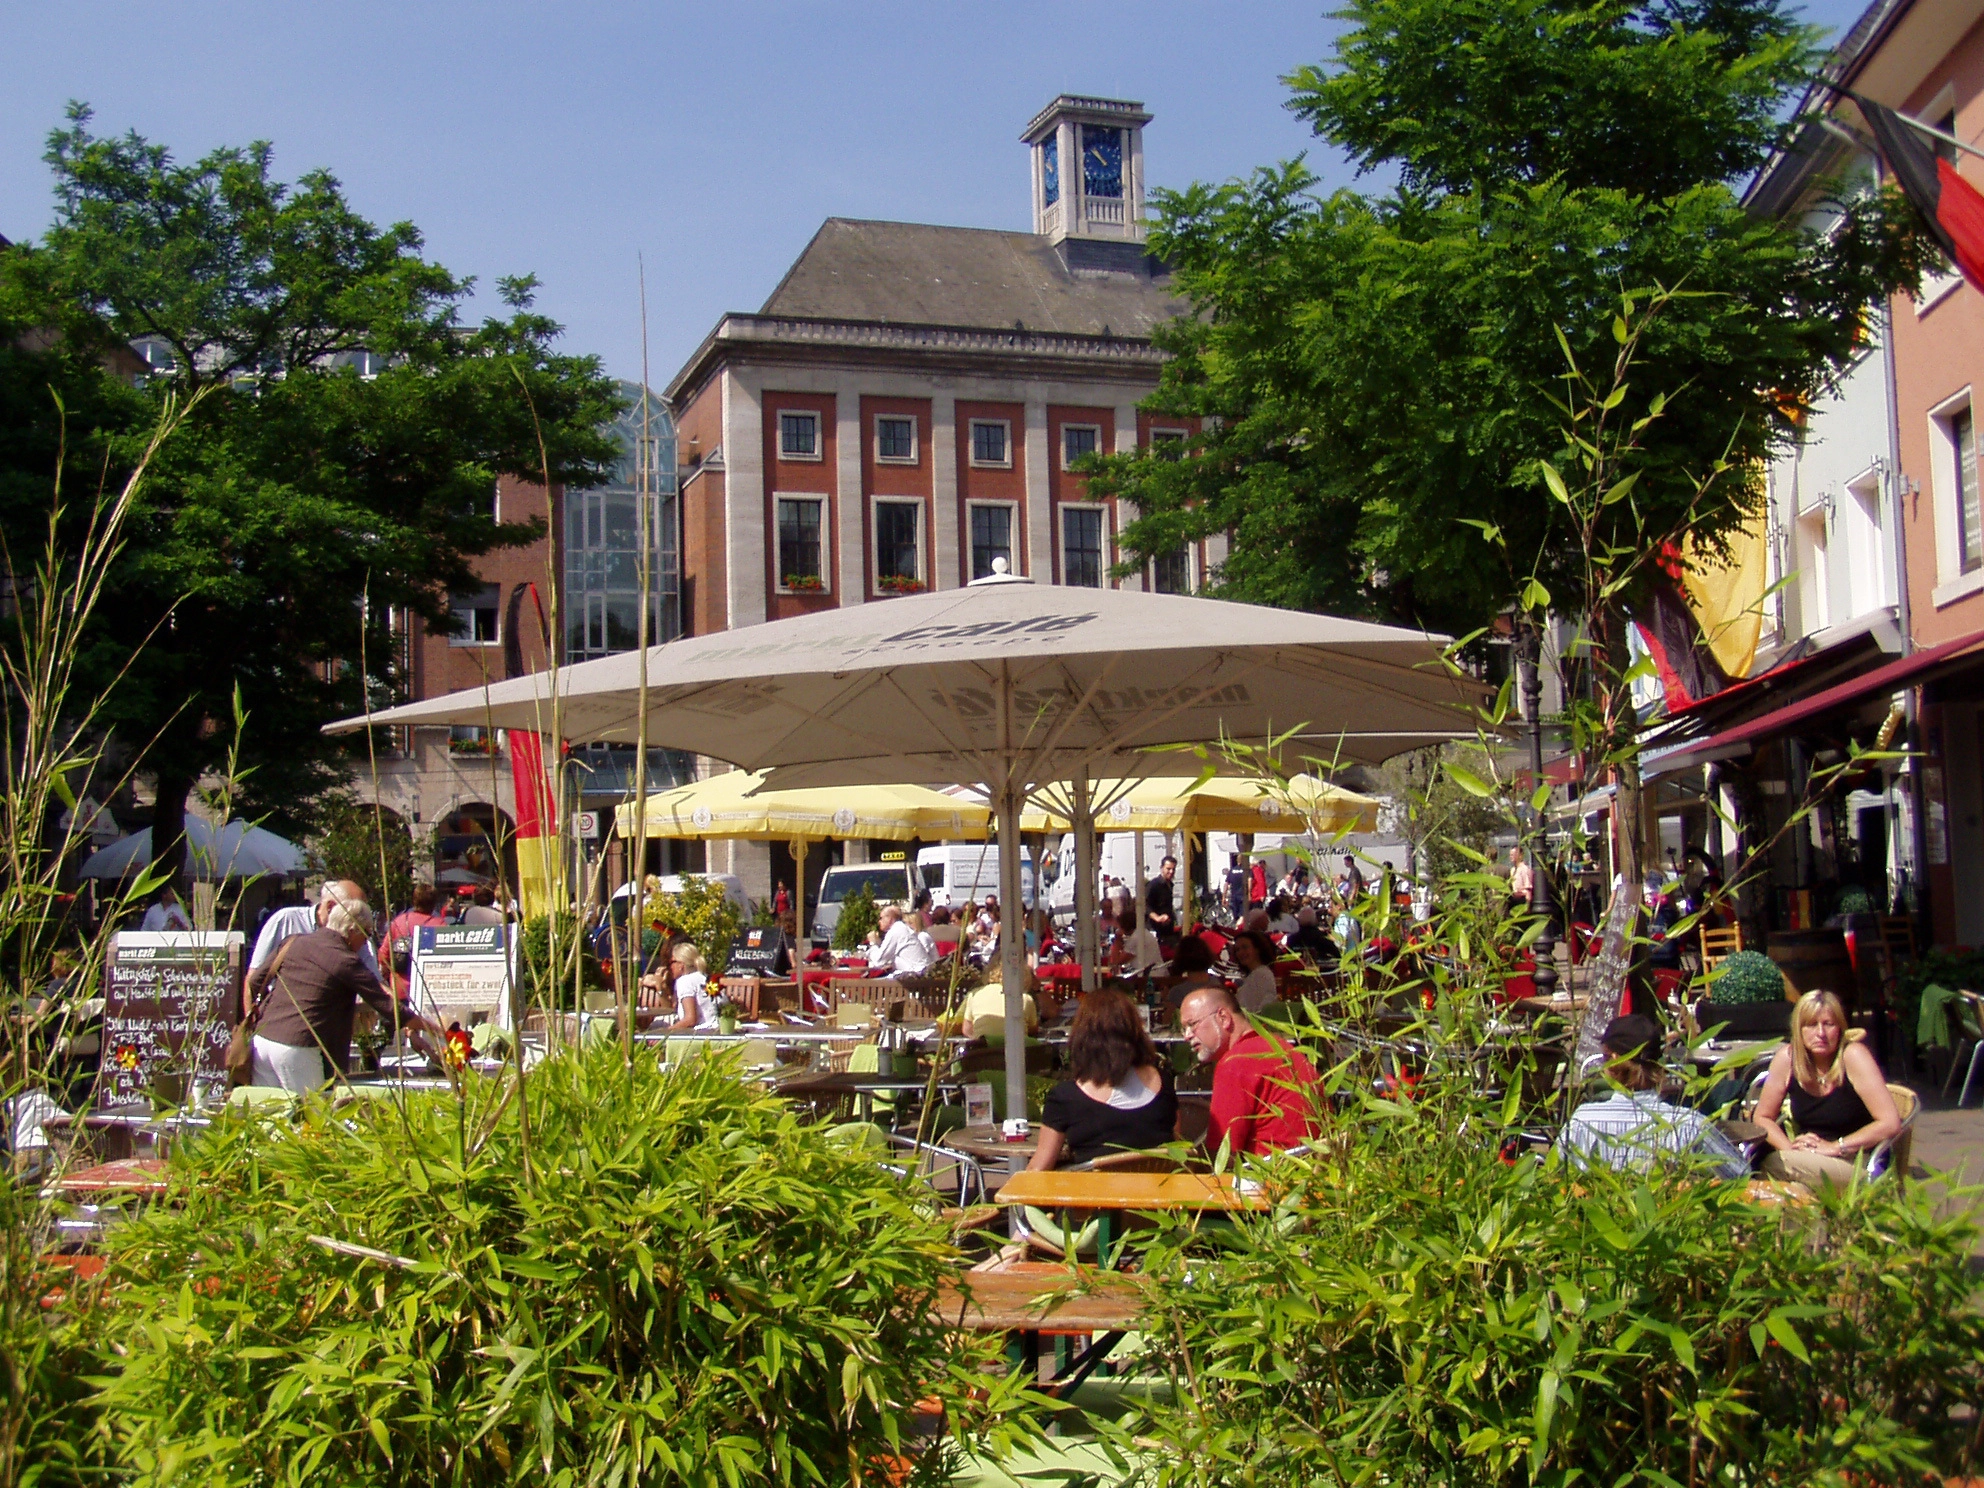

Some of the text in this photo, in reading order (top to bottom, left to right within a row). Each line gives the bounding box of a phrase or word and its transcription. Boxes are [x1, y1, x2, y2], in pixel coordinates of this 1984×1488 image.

[880, 611, 1101, 642] café
[436, 928, 495, 943] markt café
